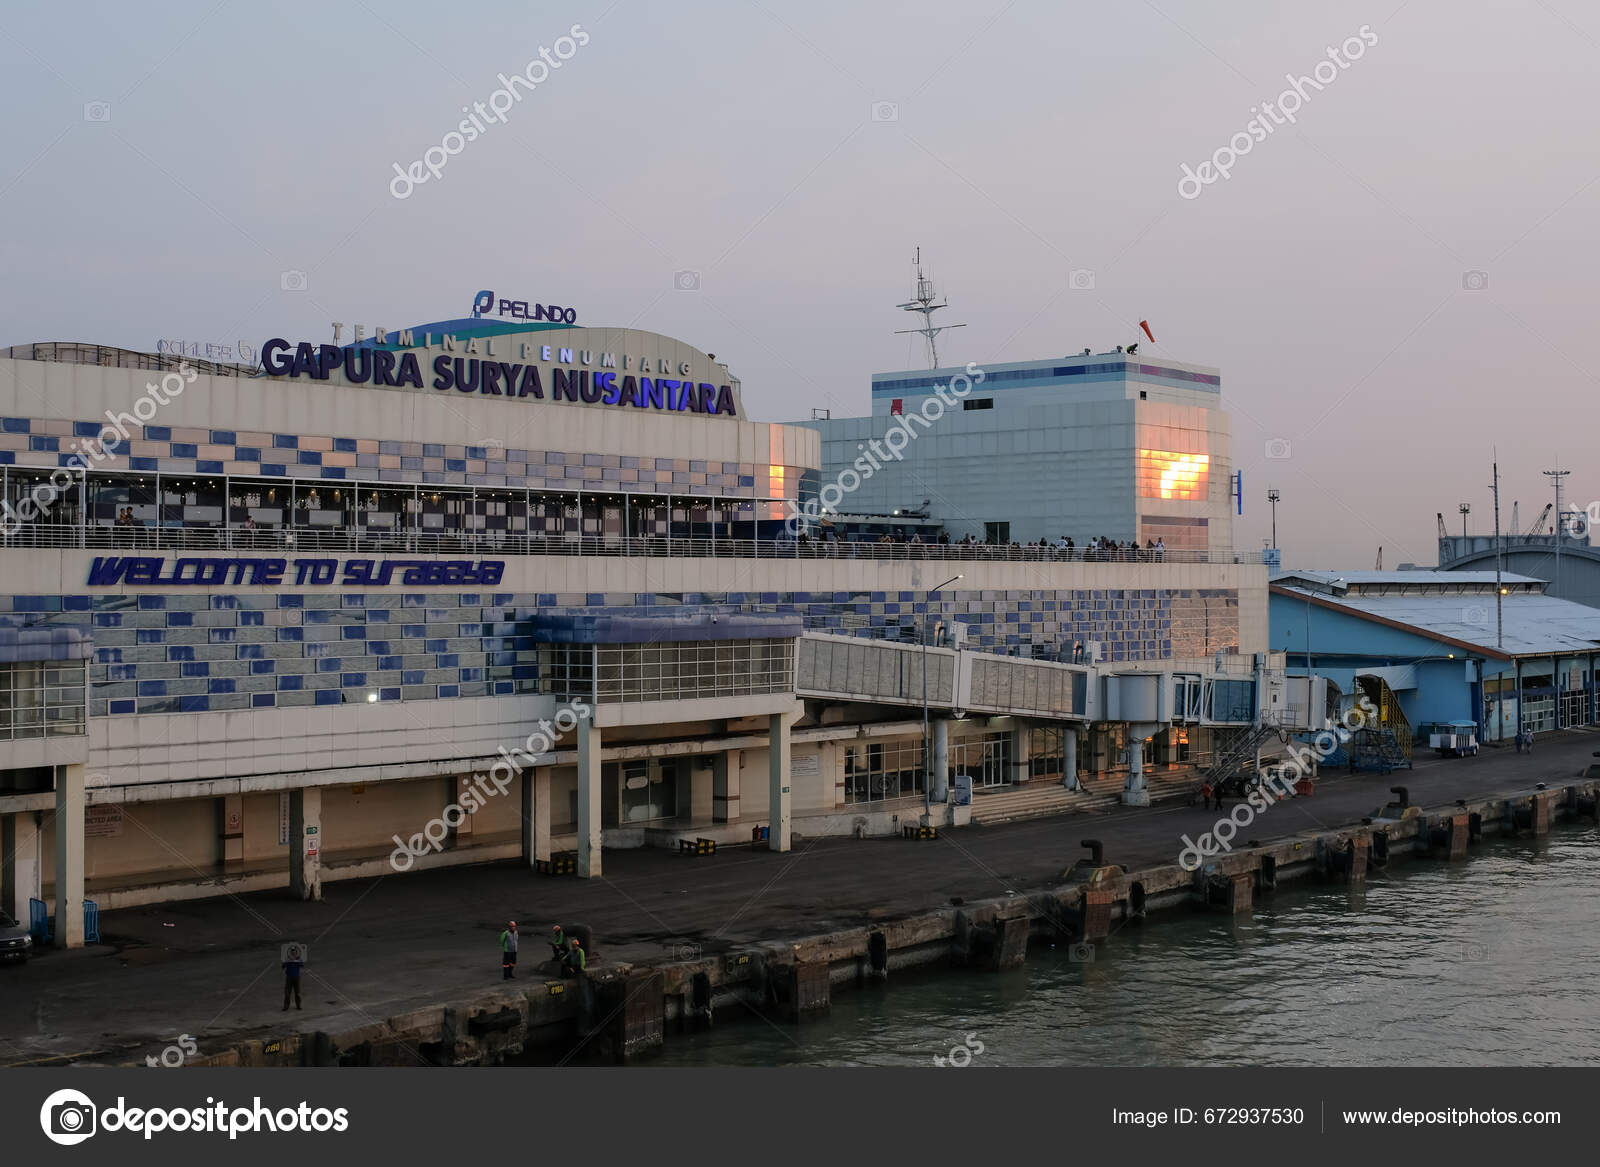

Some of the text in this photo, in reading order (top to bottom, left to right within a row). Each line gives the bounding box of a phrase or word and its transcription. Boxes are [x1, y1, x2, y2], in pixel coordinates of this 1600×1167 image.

[499, 298, 577, 325] PELINDO
[261, 338, 737, 416] GAPURA SURYA NUSANTARA
[332, 322, 692, 377] TERMINAL PENUMPANG
